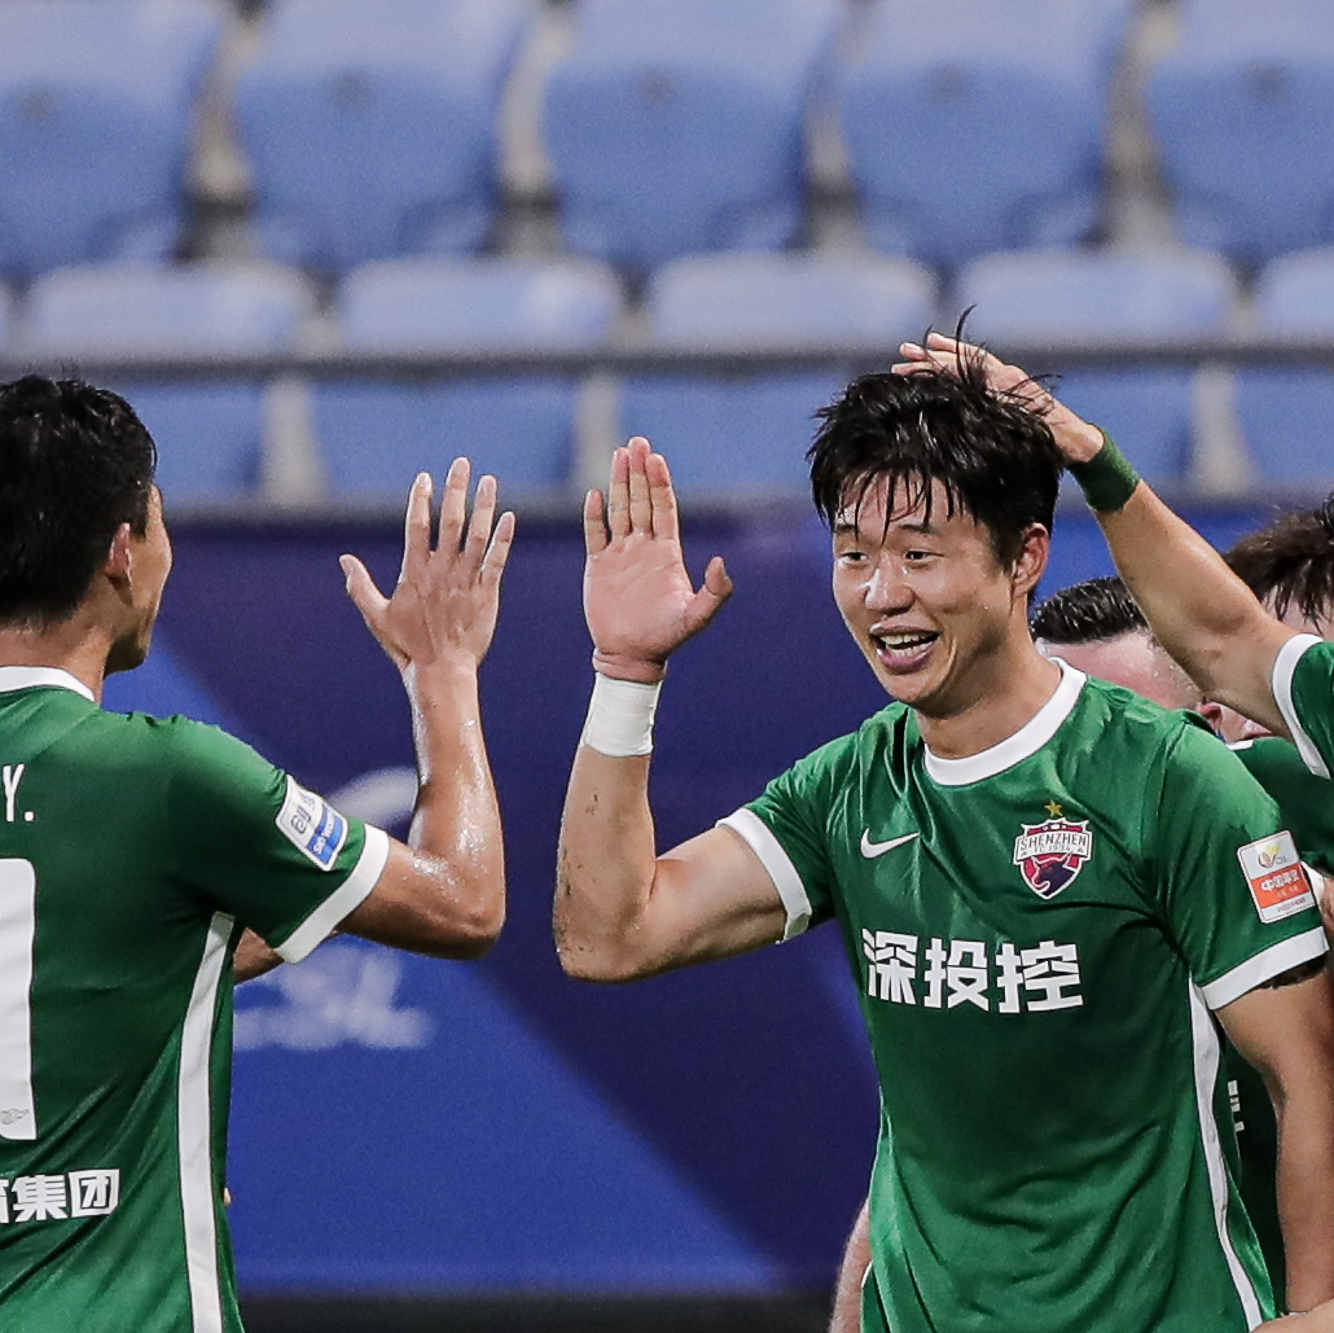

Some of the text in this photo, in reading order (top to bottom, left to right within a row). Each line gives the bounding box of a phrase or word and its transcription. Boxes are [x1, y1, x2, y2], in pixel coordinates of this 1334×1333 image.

[2, 764, 34, 822] Y.
[1020, 833, 1087, 851] SHENZHEN
[862, 928, 1084, 1014] 深投控
